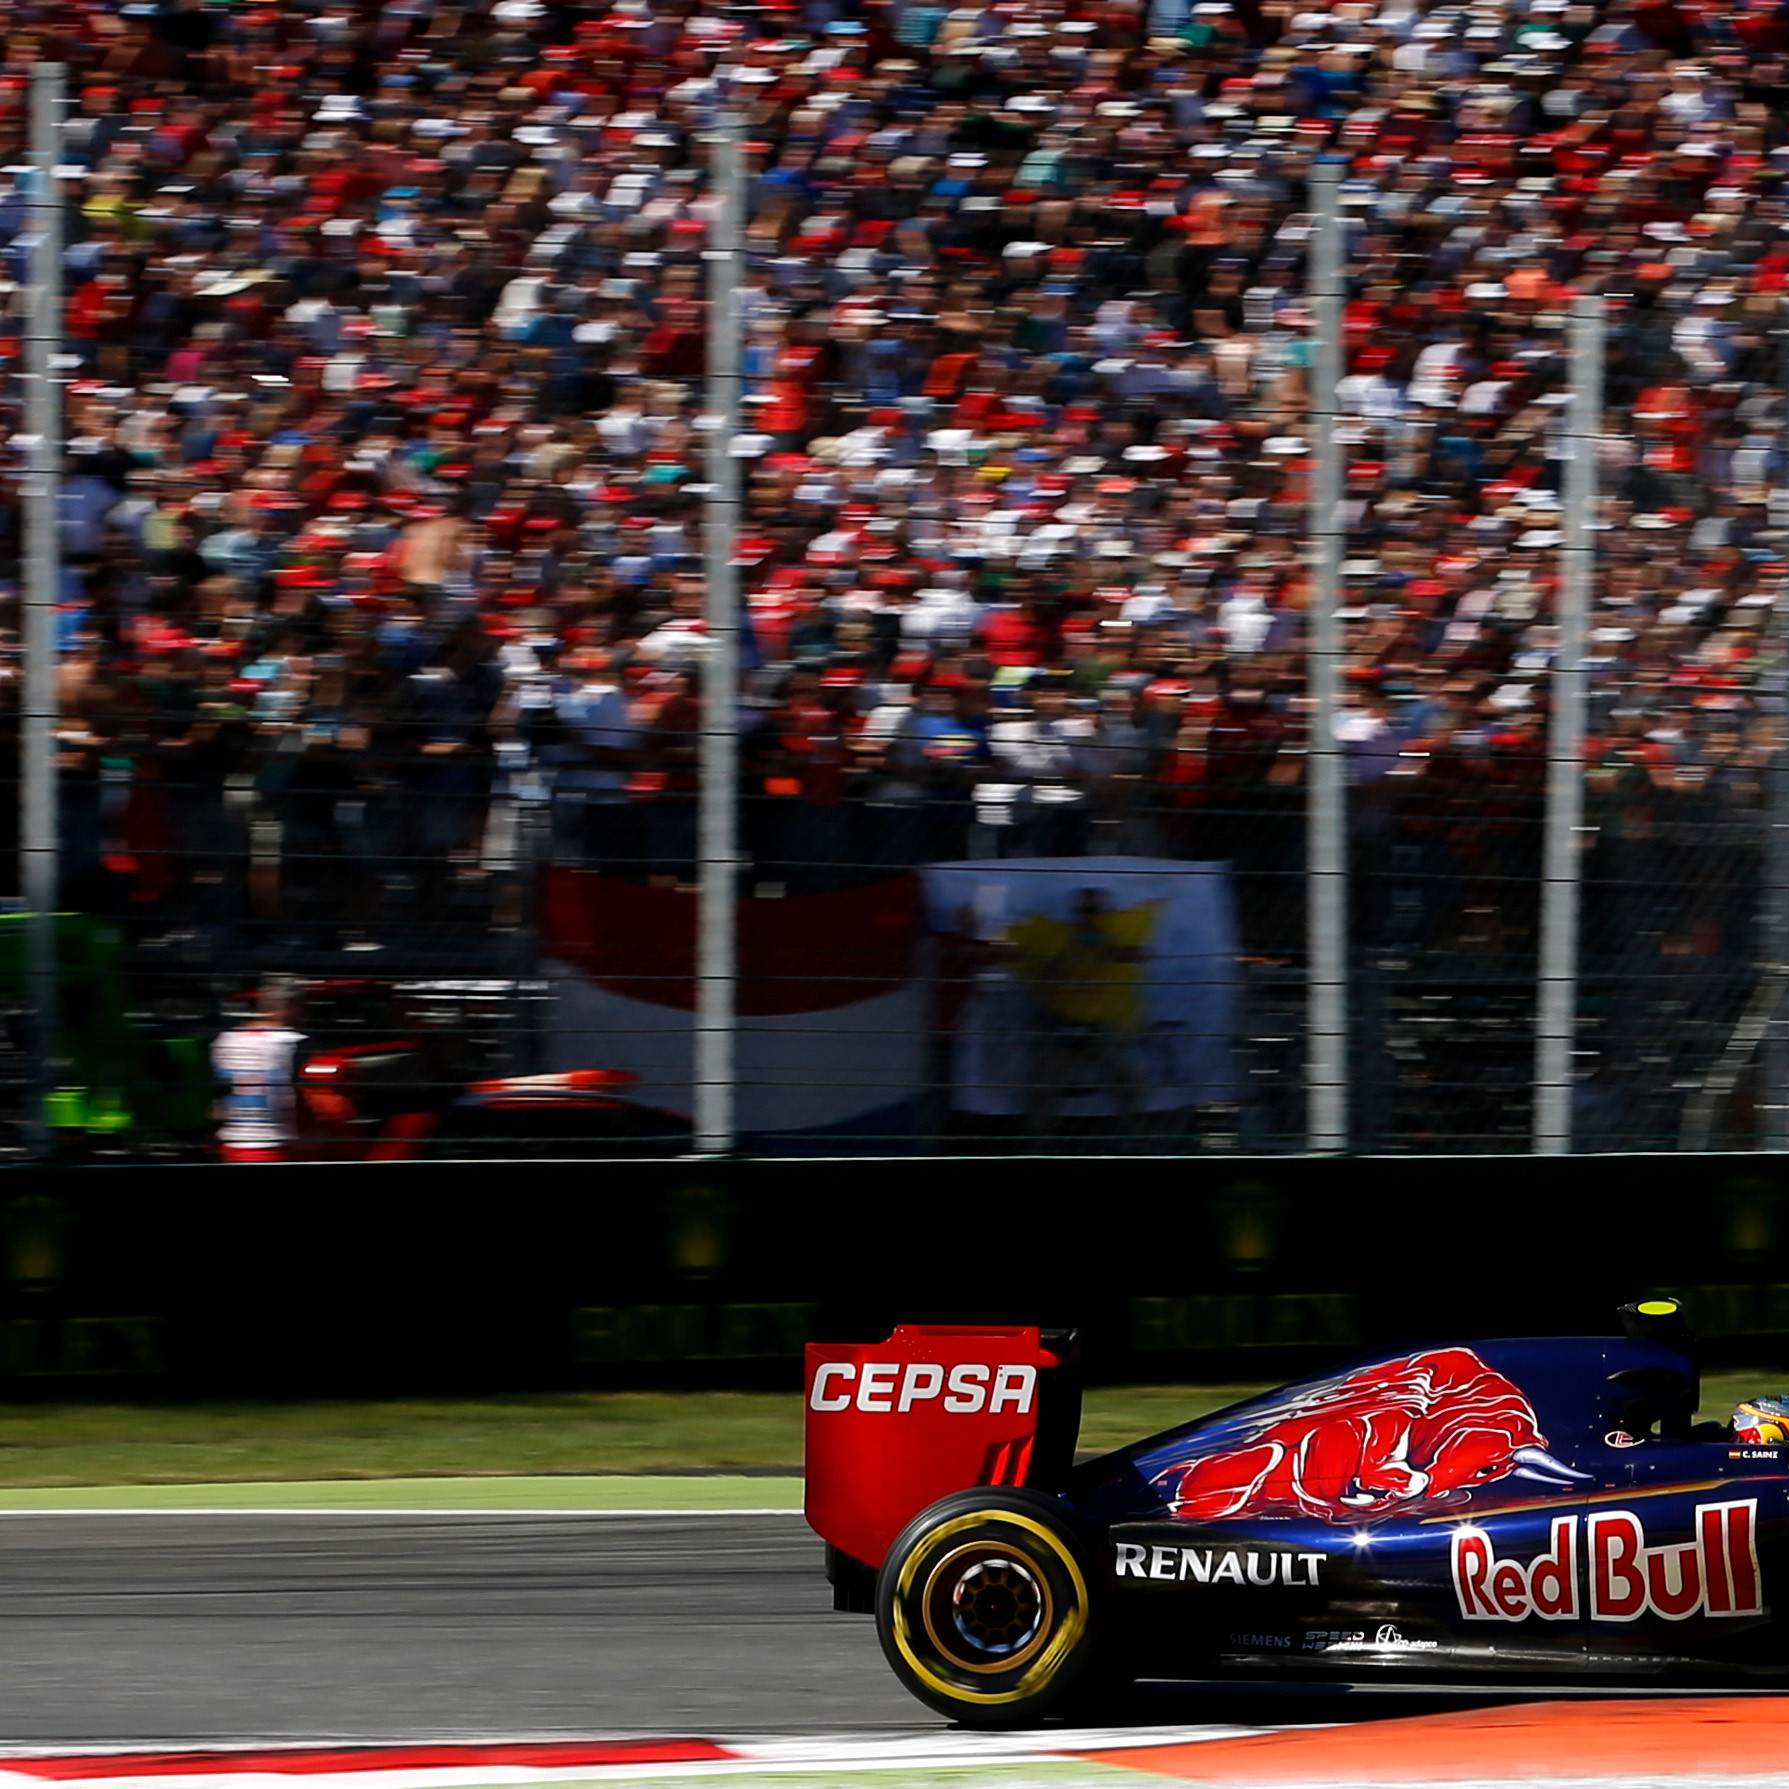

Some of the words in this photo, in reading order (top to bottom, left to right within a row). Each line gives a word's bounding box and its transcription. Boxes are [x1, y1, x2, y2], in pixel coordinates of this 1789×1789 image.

[810, 1363, 1037, 1414] CEPSA
[1115, 1543, 1327, 1586] RENAULT
[1450, 1514, 1580, 1621] Red
[1587, 1498, 1763, 1622] Bull
[1228, 1632, 1292, 1648] SIEMENS
